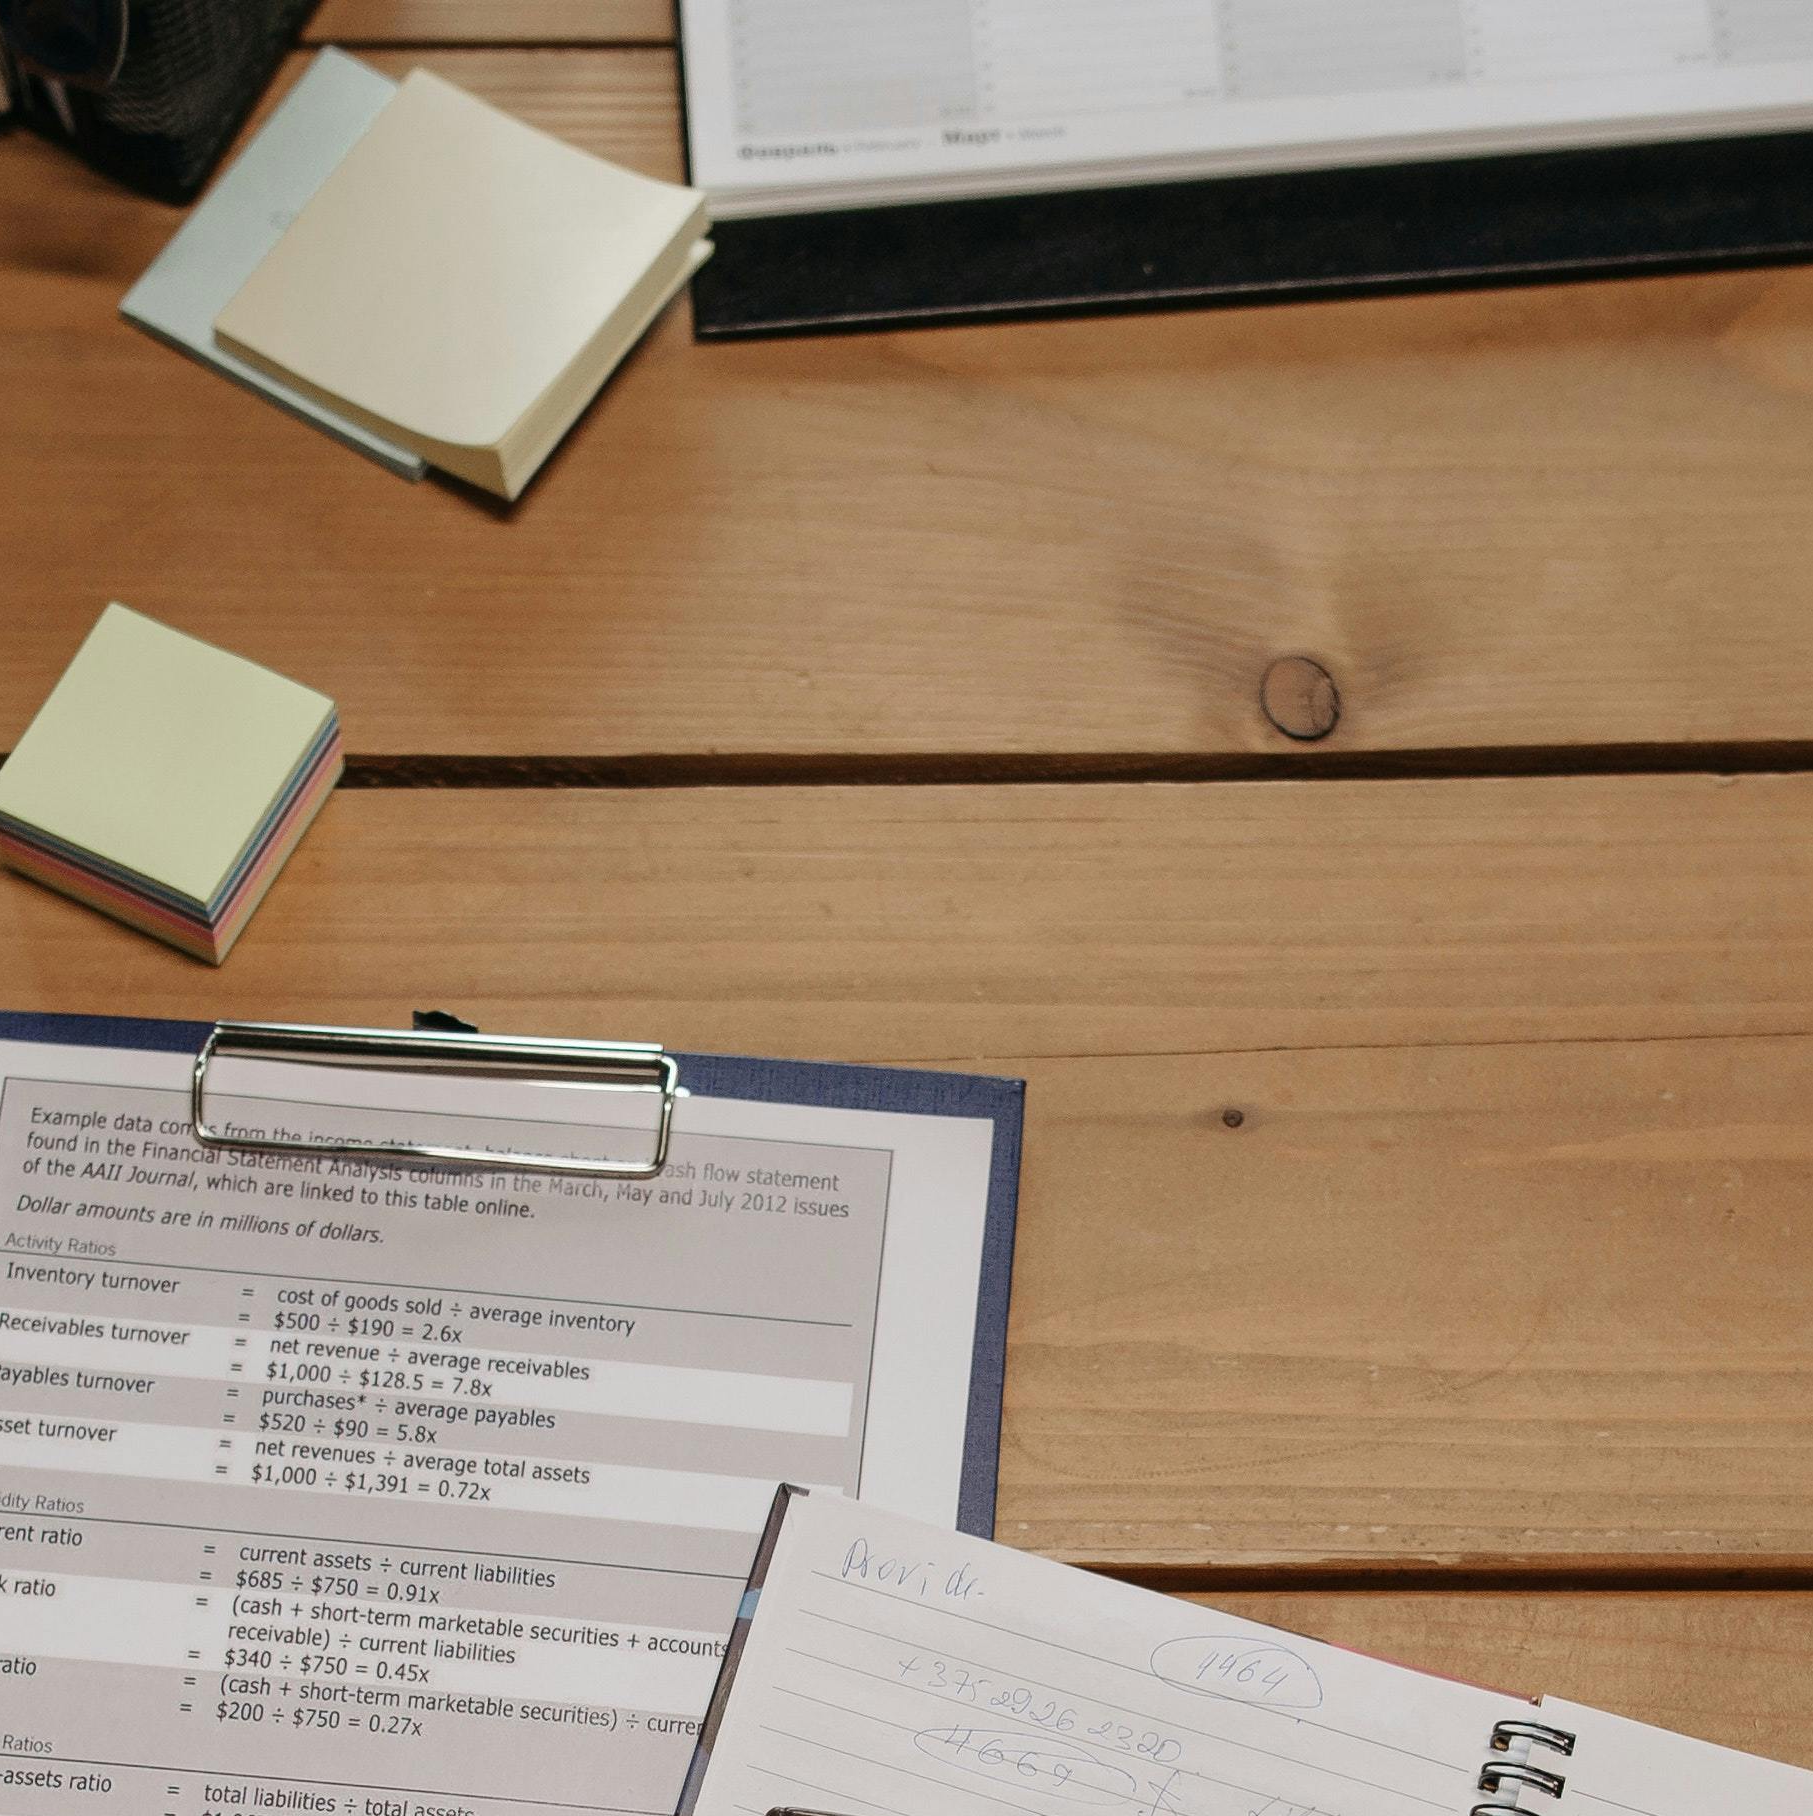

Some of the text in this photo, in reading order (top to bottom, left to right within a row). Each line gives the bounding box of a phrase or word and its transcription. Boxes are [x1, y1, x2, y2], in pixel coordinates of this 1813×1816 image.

[21, 1156, 535, 1219] of the AAII Journal, which are linked to this table online.
[15, 1193, 384, 1244] Dollar amounts are in millions of dollars.
[3, 1231, 117, 1257] Activity Ratios
[5, 1260, 181, 1294] Inventory turnover
[276, 1288, 443, 1316] cost of goods sold
[110, 1321, 192, 1346] turnover
[75, 1370, 156, 1394] turnover
[264, 1358, 493, 1398] $1,000 $128.5 7.8x
[37, 1418, 119, 1443] turnover
[34, 1495, 85, 1512] Ratios
[39, 1527, 83, 1547] ratio
[12, 1577, 57, 1598] ratio
[231, 1593, 619, 1647] (cash short-term marketable securities
[1, 1733, 53, 1754] Ratios
[68, 1772, 112, 1793] ratio
